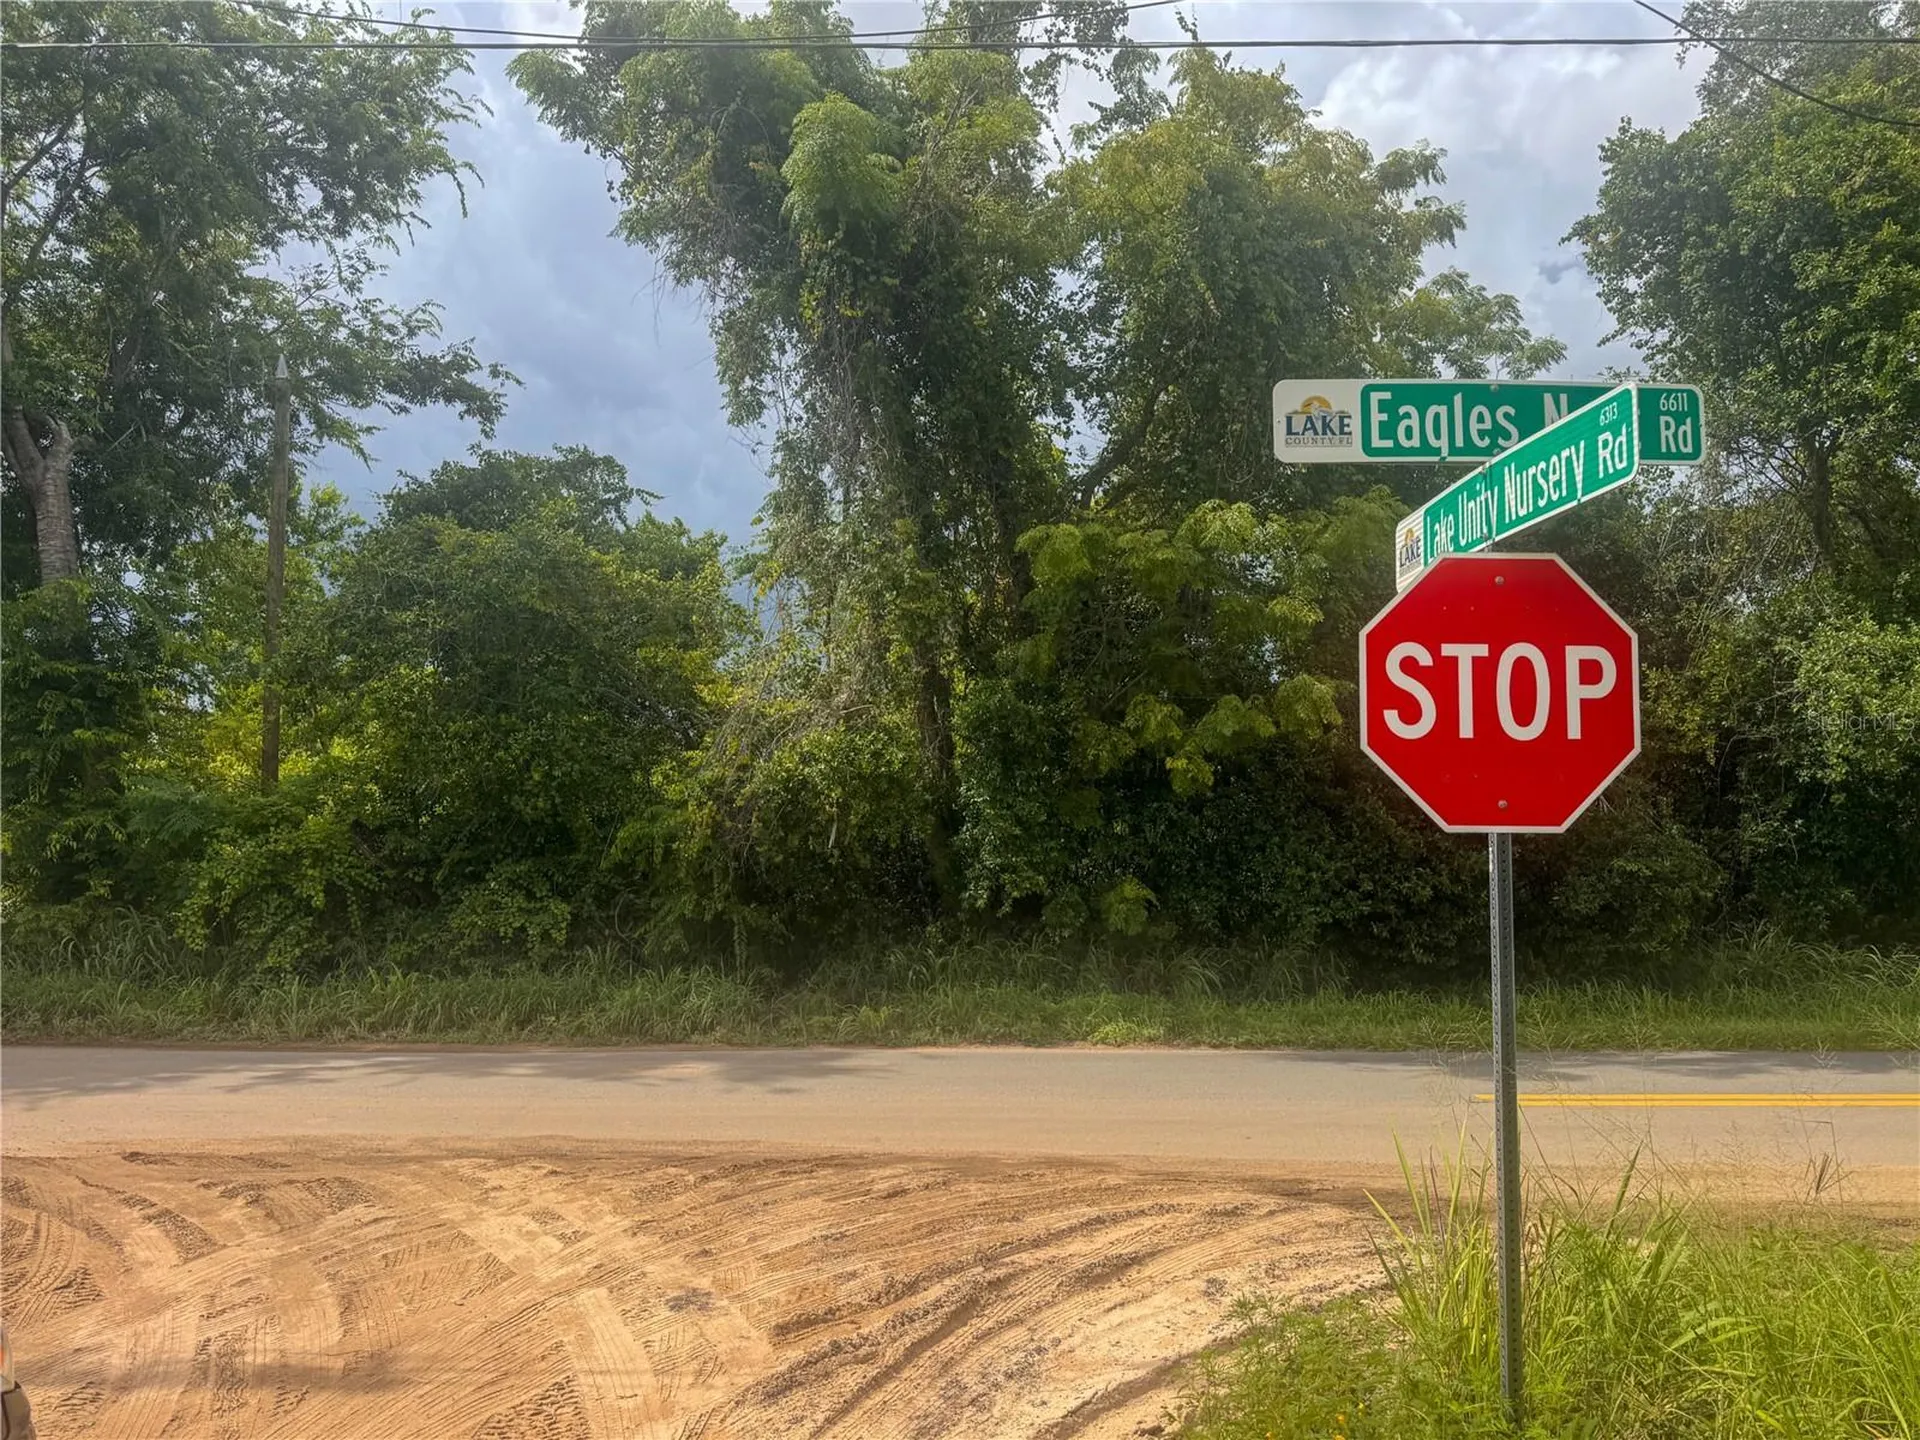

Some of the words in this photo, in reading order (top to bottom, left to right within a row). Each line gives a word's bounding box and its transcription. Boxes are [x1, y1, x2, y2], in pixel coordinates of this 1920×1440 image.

[1599, 402, 1618, 426] 6313
[1660, 392, 1688, 412] 6611
[1286, 414, 1353, 436] LAKE
[1370, 391, 1519, 459] Eagles
[1660, 415, 1693, 453] Rd
[1426, 507, 1455, 563] Lake
[1457, 483, 1498, 542] Unity
[1504, 440, 1585, 524] Nursery
[1598, 421, 1627, 479] Rd
[1399, 535, 1421, 567] LAKE
[1383, 641, 1617, 741] STOP
